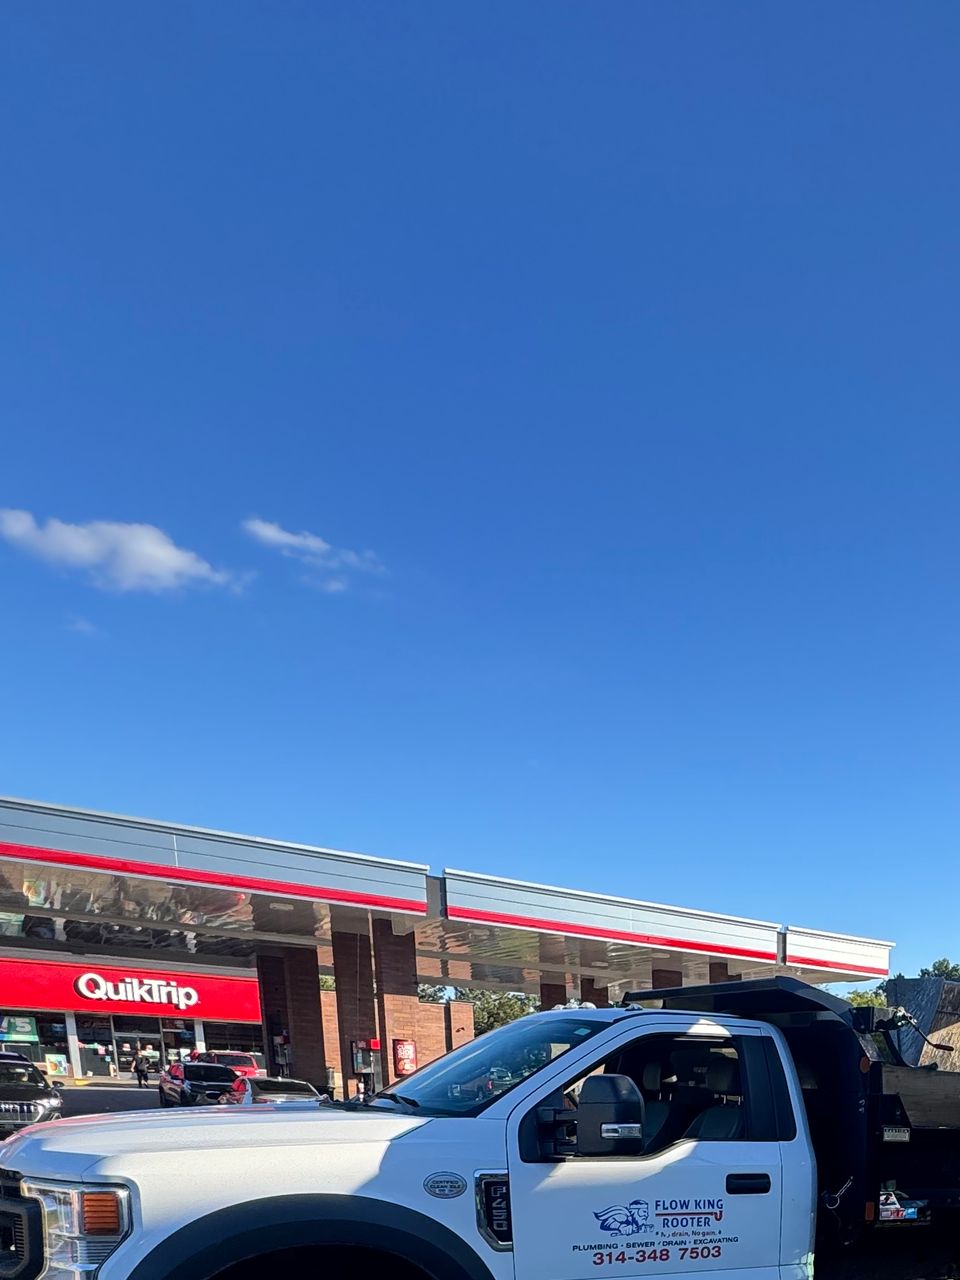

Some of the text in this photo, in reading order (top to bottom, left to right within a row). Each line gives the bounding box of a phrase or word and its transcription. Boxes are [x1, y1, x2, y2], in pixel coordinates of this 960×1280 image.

[76, 972, 199, 1010] QuikTrip
[655, 1199, 724, 1210] FLOW KING
[662, 1217, 711, 1229] ROOTER
[572, 1243, 619, 1252] PLUMBING
[625, 1241, 656, 1249] SEWER
[693, 1236, 739, 1245] EXCAVATING
[592, 1245, 722, 1266] 314-348 7503
